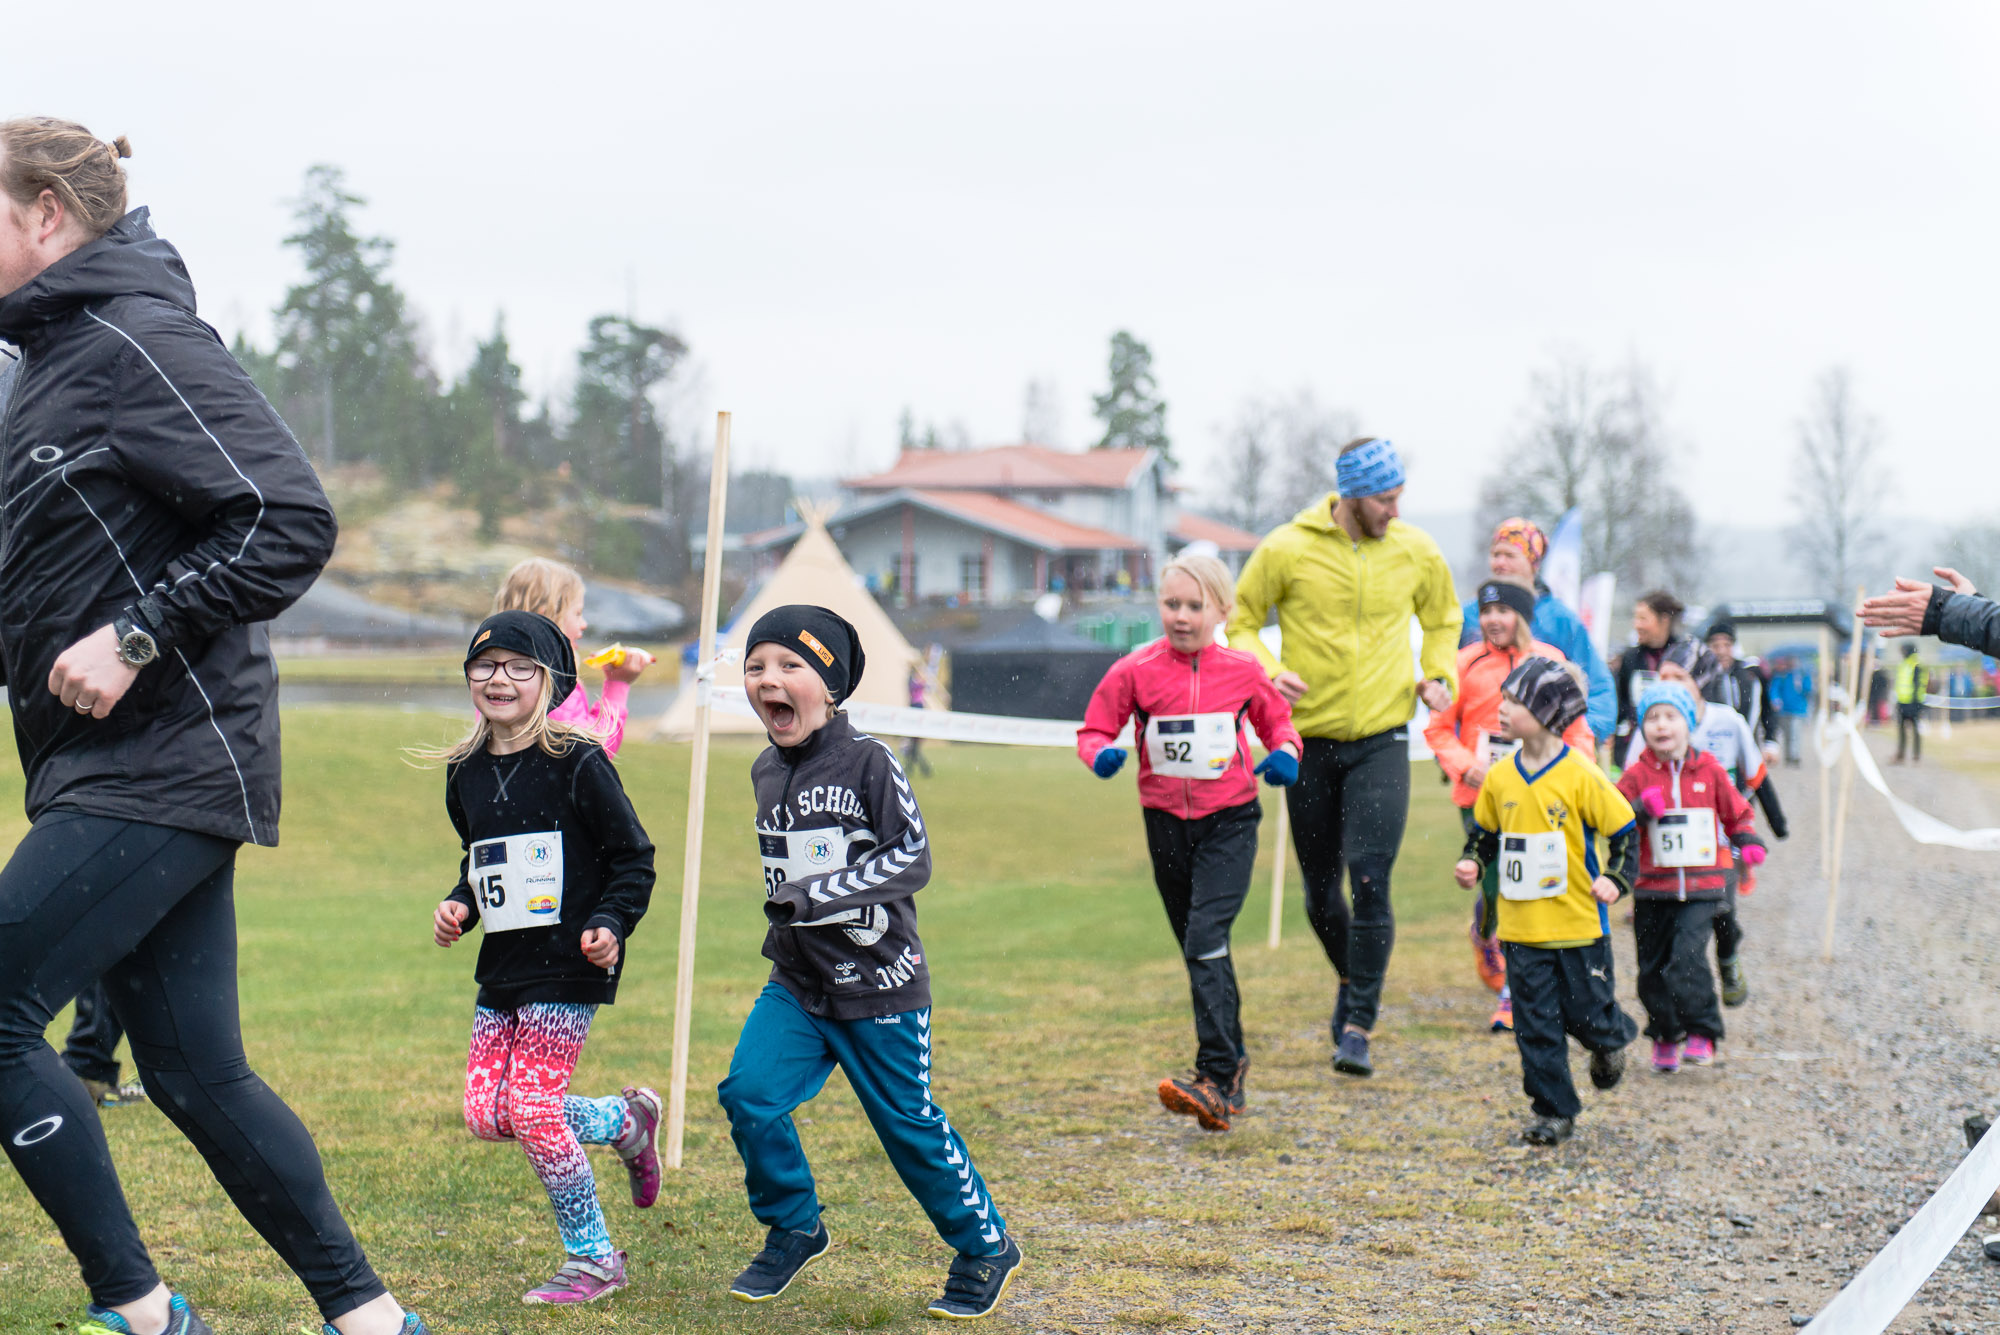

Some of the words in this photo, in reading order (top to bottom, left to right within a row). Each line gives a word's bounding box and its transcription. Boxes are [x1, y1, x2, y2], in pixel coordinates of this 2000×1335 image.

[808, 639, 832, 663] BOLIST
[1164, 741, 1193, 763] 52
[1662, 833, 1683, 851] 51
[1506, 859, 1523, 882] 40
[479, 874, 506, 909] 45
[835, 973, 861, 985] hummel
[875, 1014, 901, 1024] hummel
